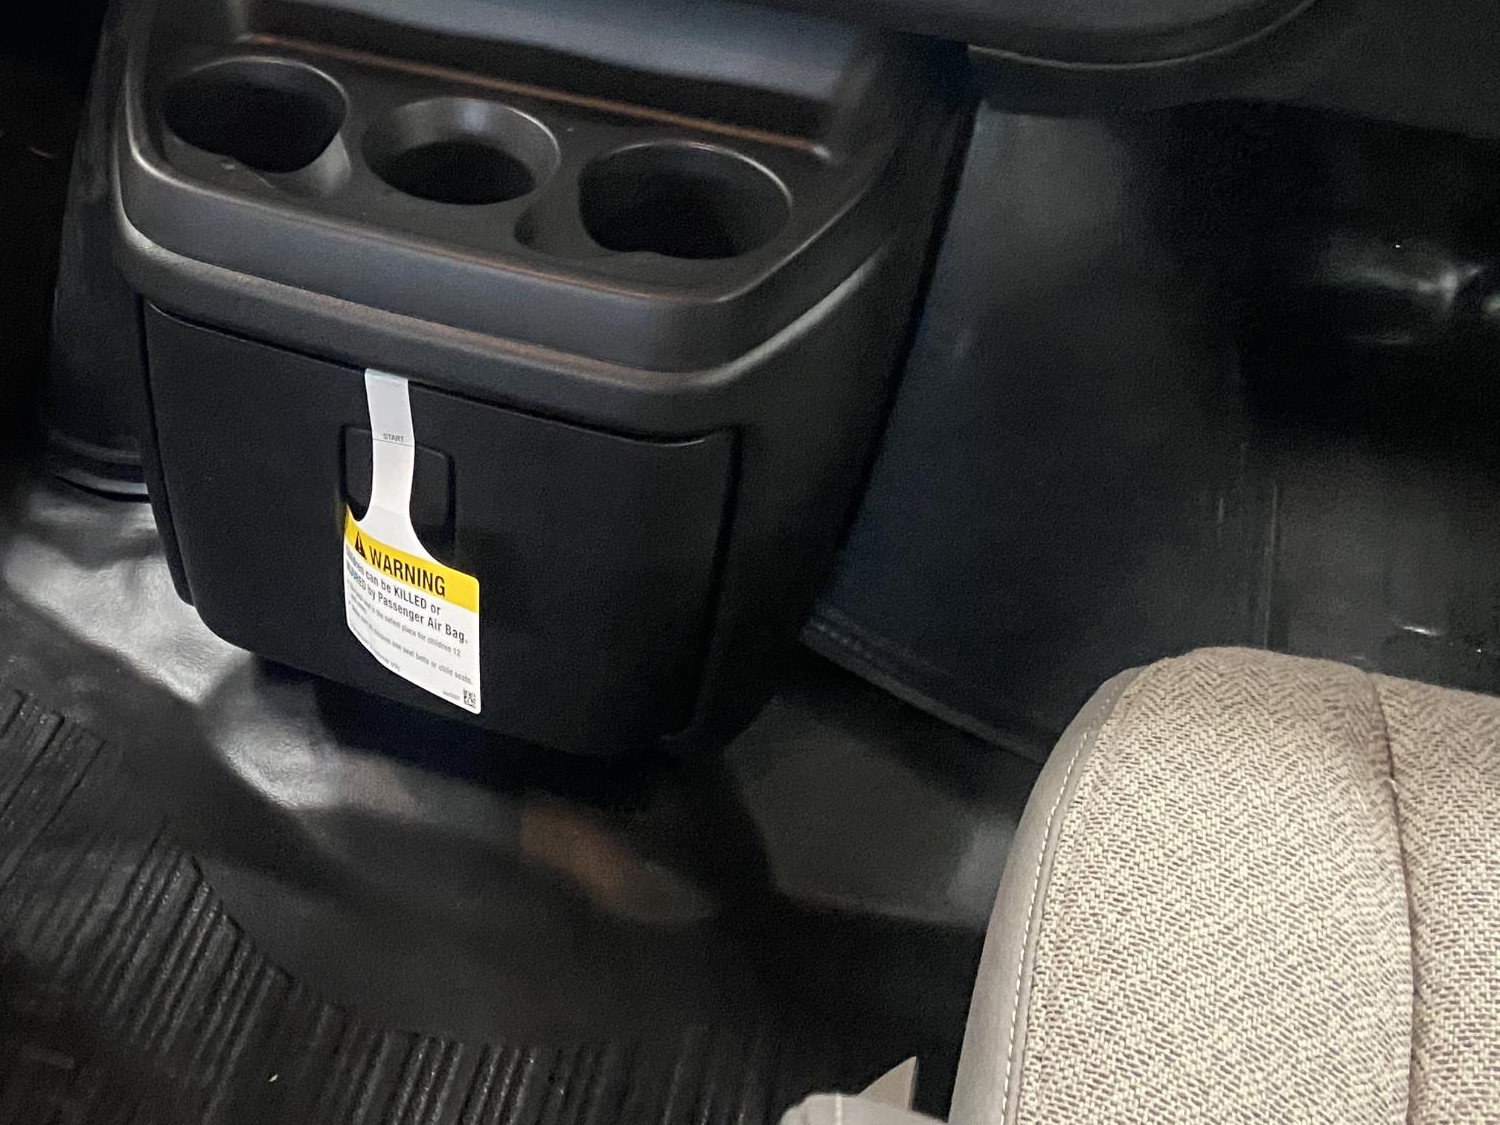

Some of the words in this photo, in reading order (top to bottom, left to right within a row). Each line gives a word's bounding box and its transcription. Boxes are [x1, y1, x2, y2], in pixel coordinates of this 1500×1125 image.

[382, 433, 404, 443] START
[365, 570, 379, 586] can
[381, 578, 391, 593] be
[394, 585, 427, 610] KILLED
[430, 603, 441, 616] or
[368, 544, 446, 597] WARNING
[368, 584, 376, 601] by
[378, 592, 424, 624] Passenger
[427, 616, 442, 632] Air
[445, 623, 469, 644] Bag.
[427, 636, 452, 654] children
[453, 647, 461, 657] 12
